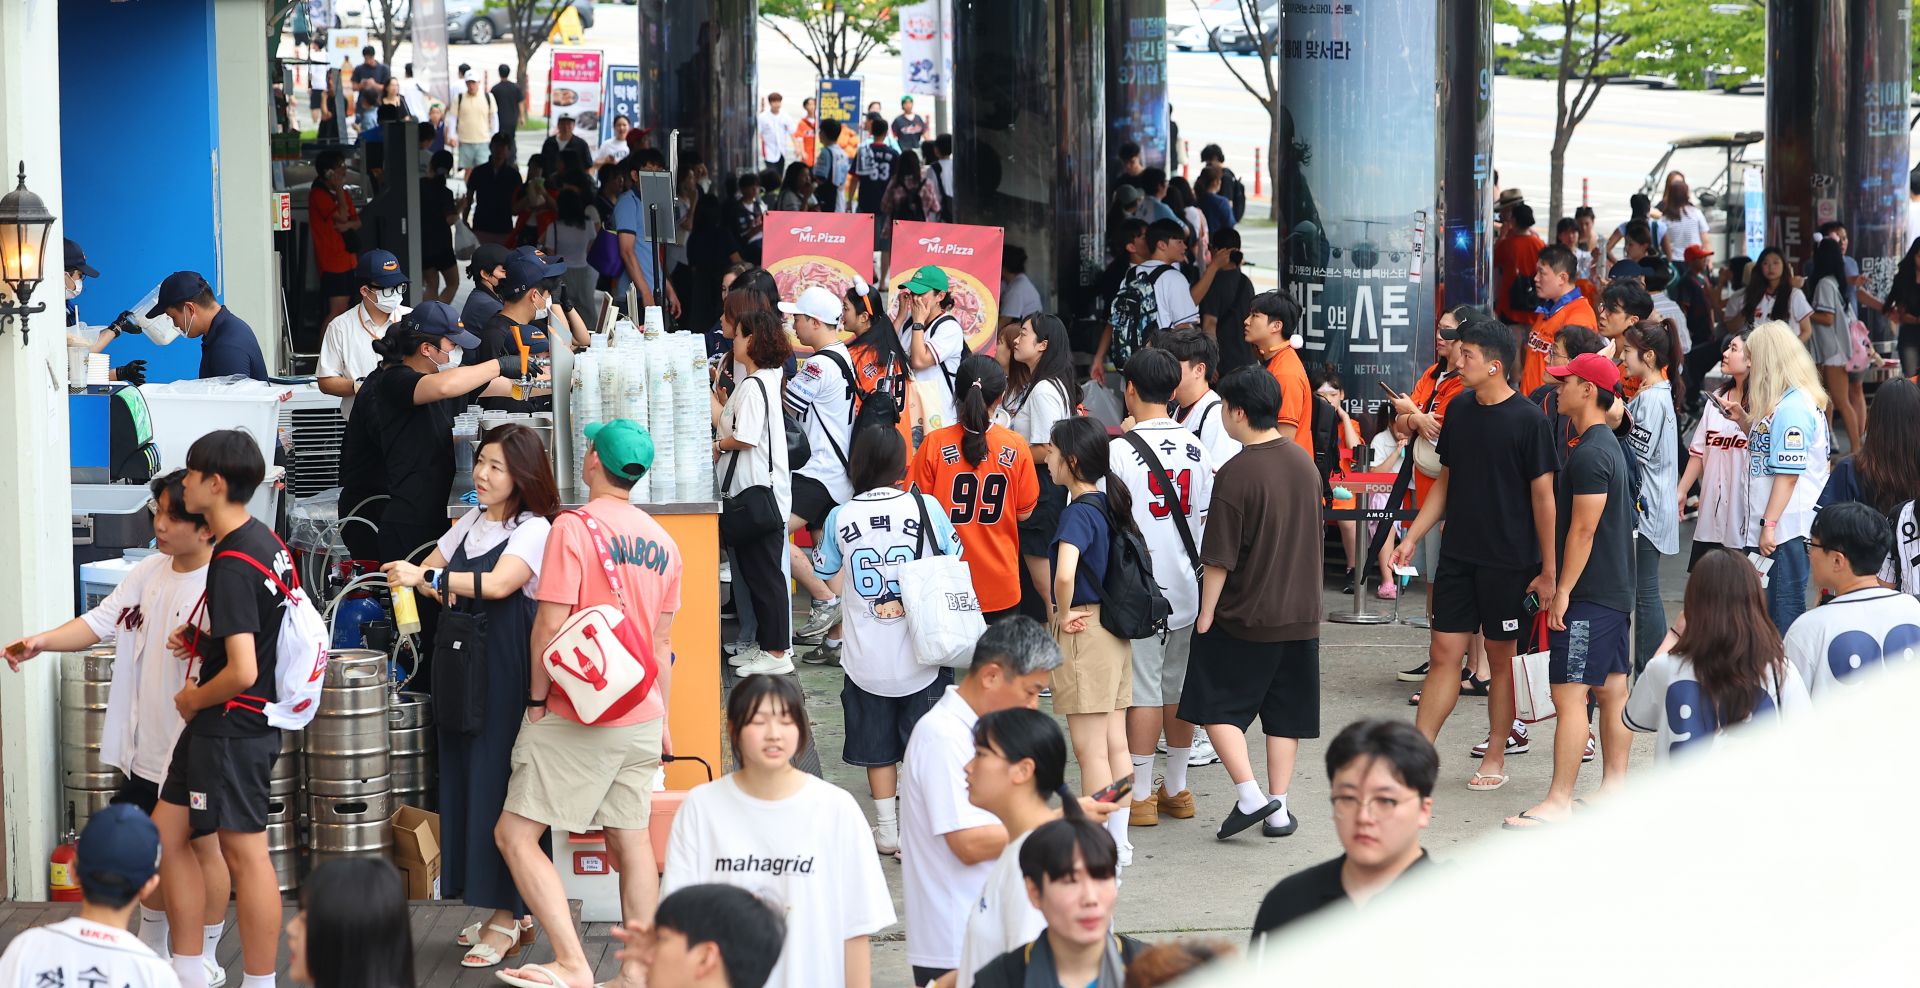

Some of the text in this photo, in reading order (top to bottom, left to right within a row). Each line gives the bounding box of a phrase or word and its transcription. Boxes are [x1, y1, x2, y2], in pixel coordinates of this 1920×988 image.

[1306, 41, 1351, 60] 맞서라
[799, 231, 845, 243] Mr.Pizza
[927, 242, 974, 255] Mr.Pizza
[1313, 267, 1341, 278] 서스펜스
[1344, 268, 1360, 279] 액션
[1363, 268, 1407, 279] 블록버스터
[1328, 306, 1347, 330] 오브
[1349, 285, 1410, 353] 스톤
[1355, 364, 1390, 375] NETFLIX
[1705, 430, 1748, 450] Eagle
[941, 444, 1017, 468] 류진
[949, 472, 1008, 525] 99
[1148, 469, 1193, 520] 51
